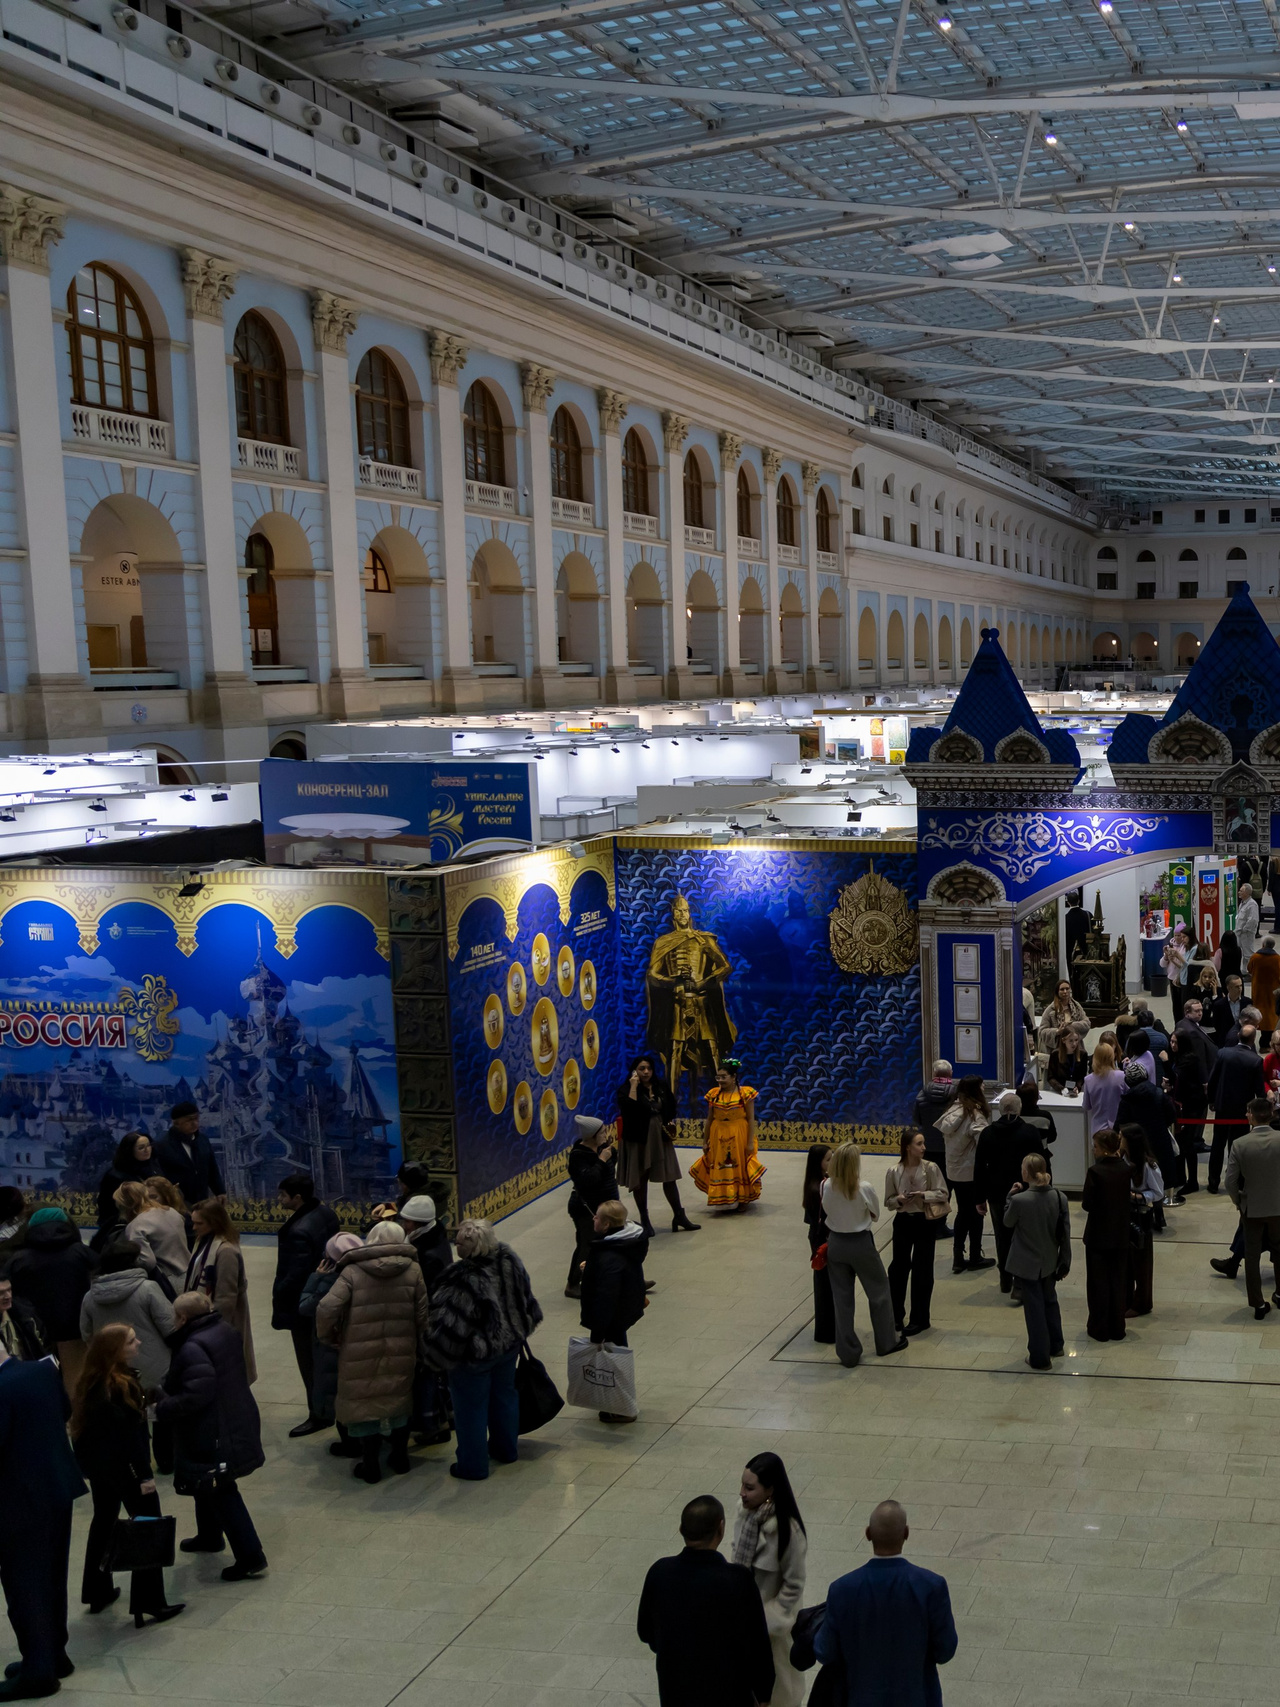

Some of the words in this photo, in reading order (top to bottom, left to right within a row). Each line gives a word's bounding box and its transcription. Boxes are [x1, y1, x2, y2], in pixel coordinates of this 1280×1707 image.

[101, 576, 123, 586] ESTER
[297, 783, 389, 799] КОНФЕРЕНЦ-ЗАЛ
[580, 912, 591, 924] 325
[591, 910, 601, 921] ЛЕТ
[470, 944, 483, 958] 140
[483, 942, 495, 954] ЛЕТ
[0, 1000, 128, 1014] икальная
